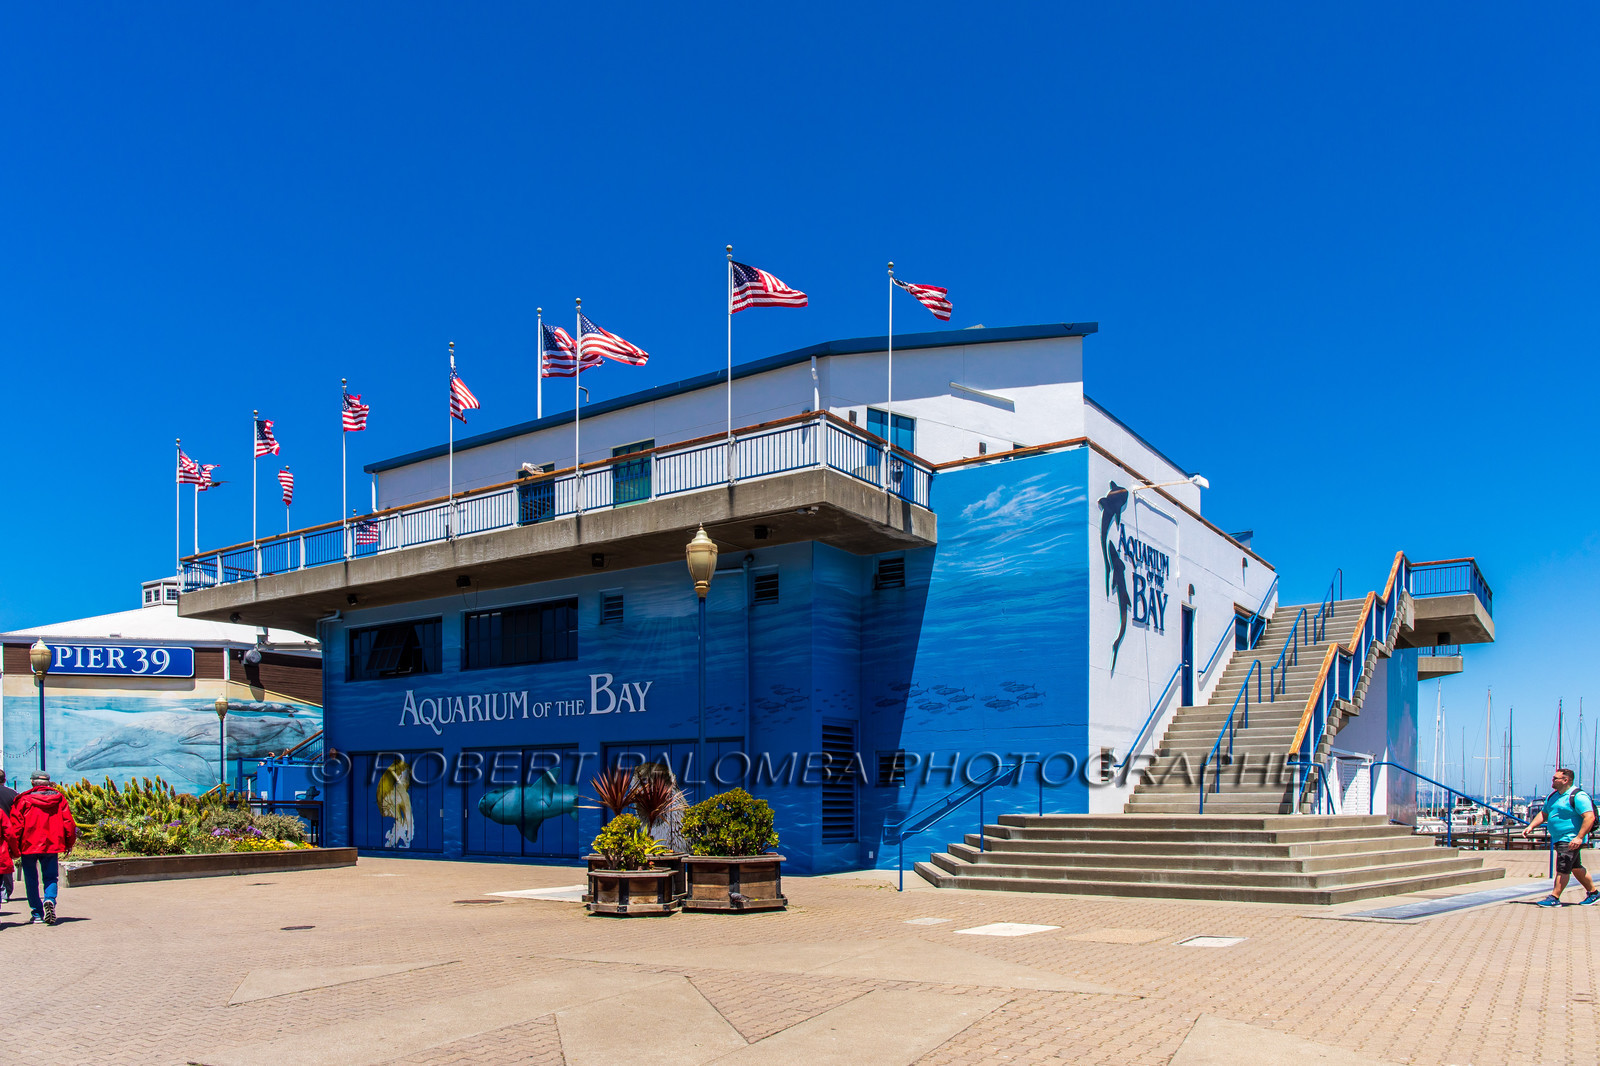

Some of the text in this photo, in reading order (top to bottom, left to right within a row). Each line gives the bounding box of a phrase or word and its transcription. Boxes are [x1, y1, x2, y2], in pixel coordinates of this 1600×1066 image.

[1117, 523, 1169, 577] AQUARIUM
[1146, 571, 1154, 583] OF
[1132, 572, 1168, 631] BAY
[53, 646, 171, 674] PIER 39
[398, 672, 653, 735] AQUARIUM OF THE BAY
